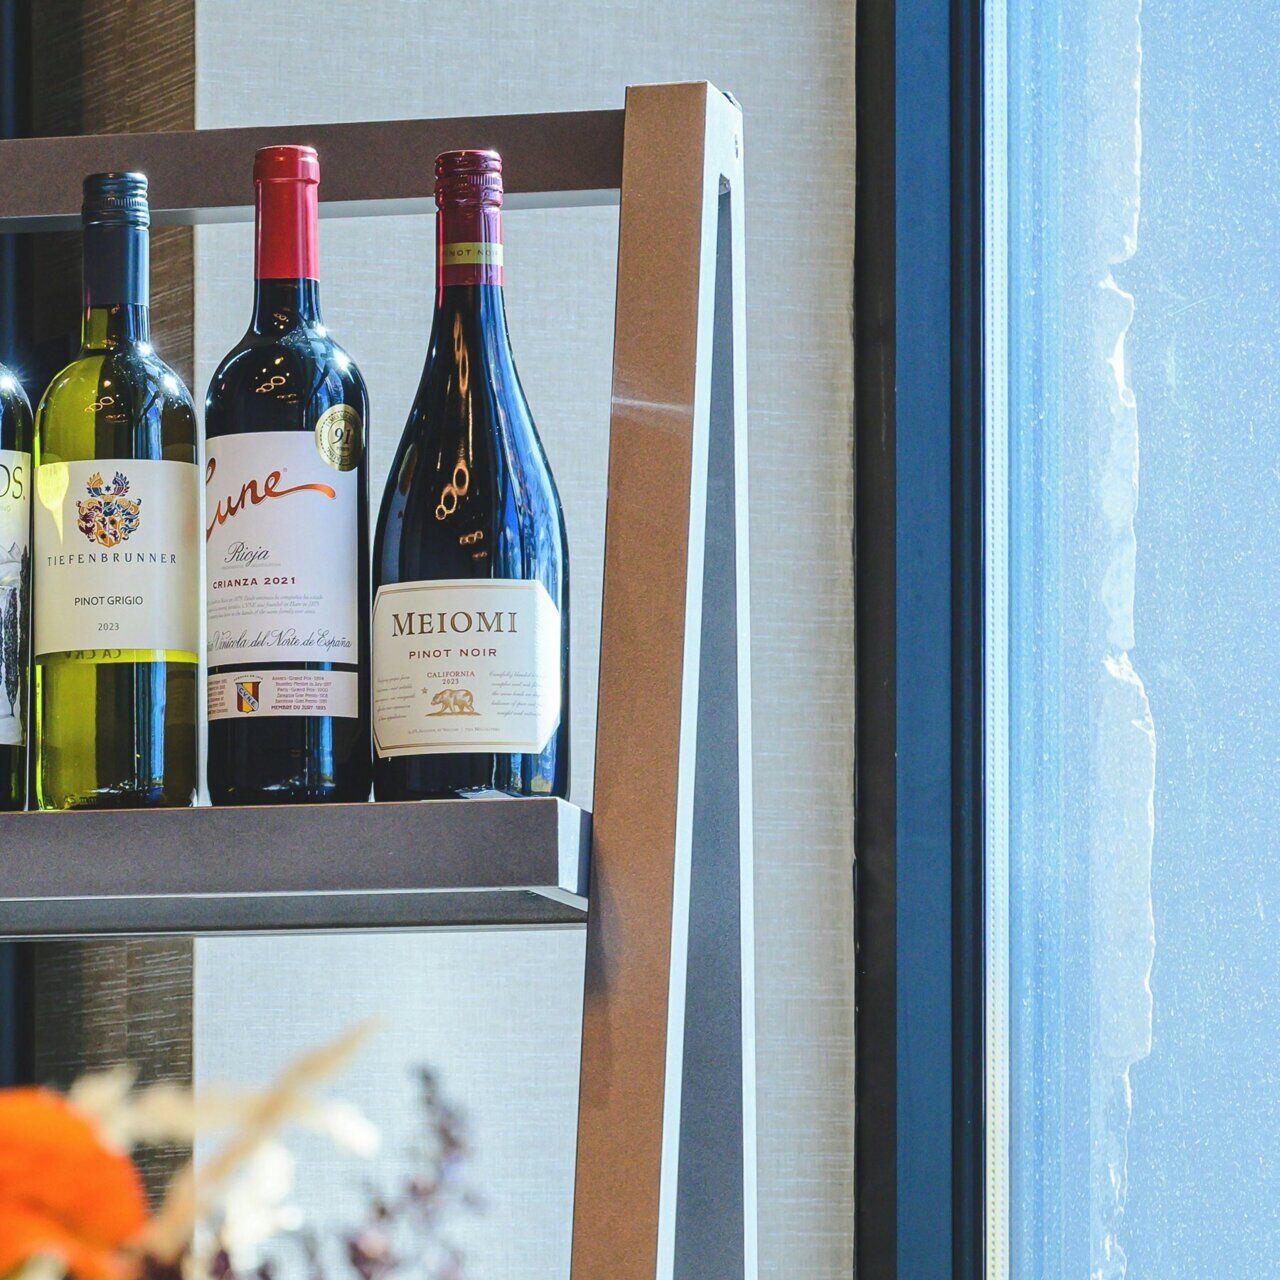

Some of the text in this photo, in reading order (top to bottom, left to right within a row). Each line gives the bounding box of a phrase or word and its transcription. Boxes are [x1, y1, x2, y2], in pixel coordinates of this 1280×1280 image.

[332, 428, 350, 444] 91
[48, 553, 176, 566] TIEFENBRUNNER
[224, 542, 269, 567] Rioja
[213, 577, 295, 589] CRIANZA 2021
[74, 596, 143, 606] PINOT GRIGIO
[98, 623, 119, 631] 2023
[392, 611, 517, 637] MEIOMI
[248, 631, 266, 647] del
[267, 628, 299, 646] Norte
[300, 632, 313, 646] de
[317, 628, 351, 651] España
[409, 648, 497, 659] PINOT NOIR
